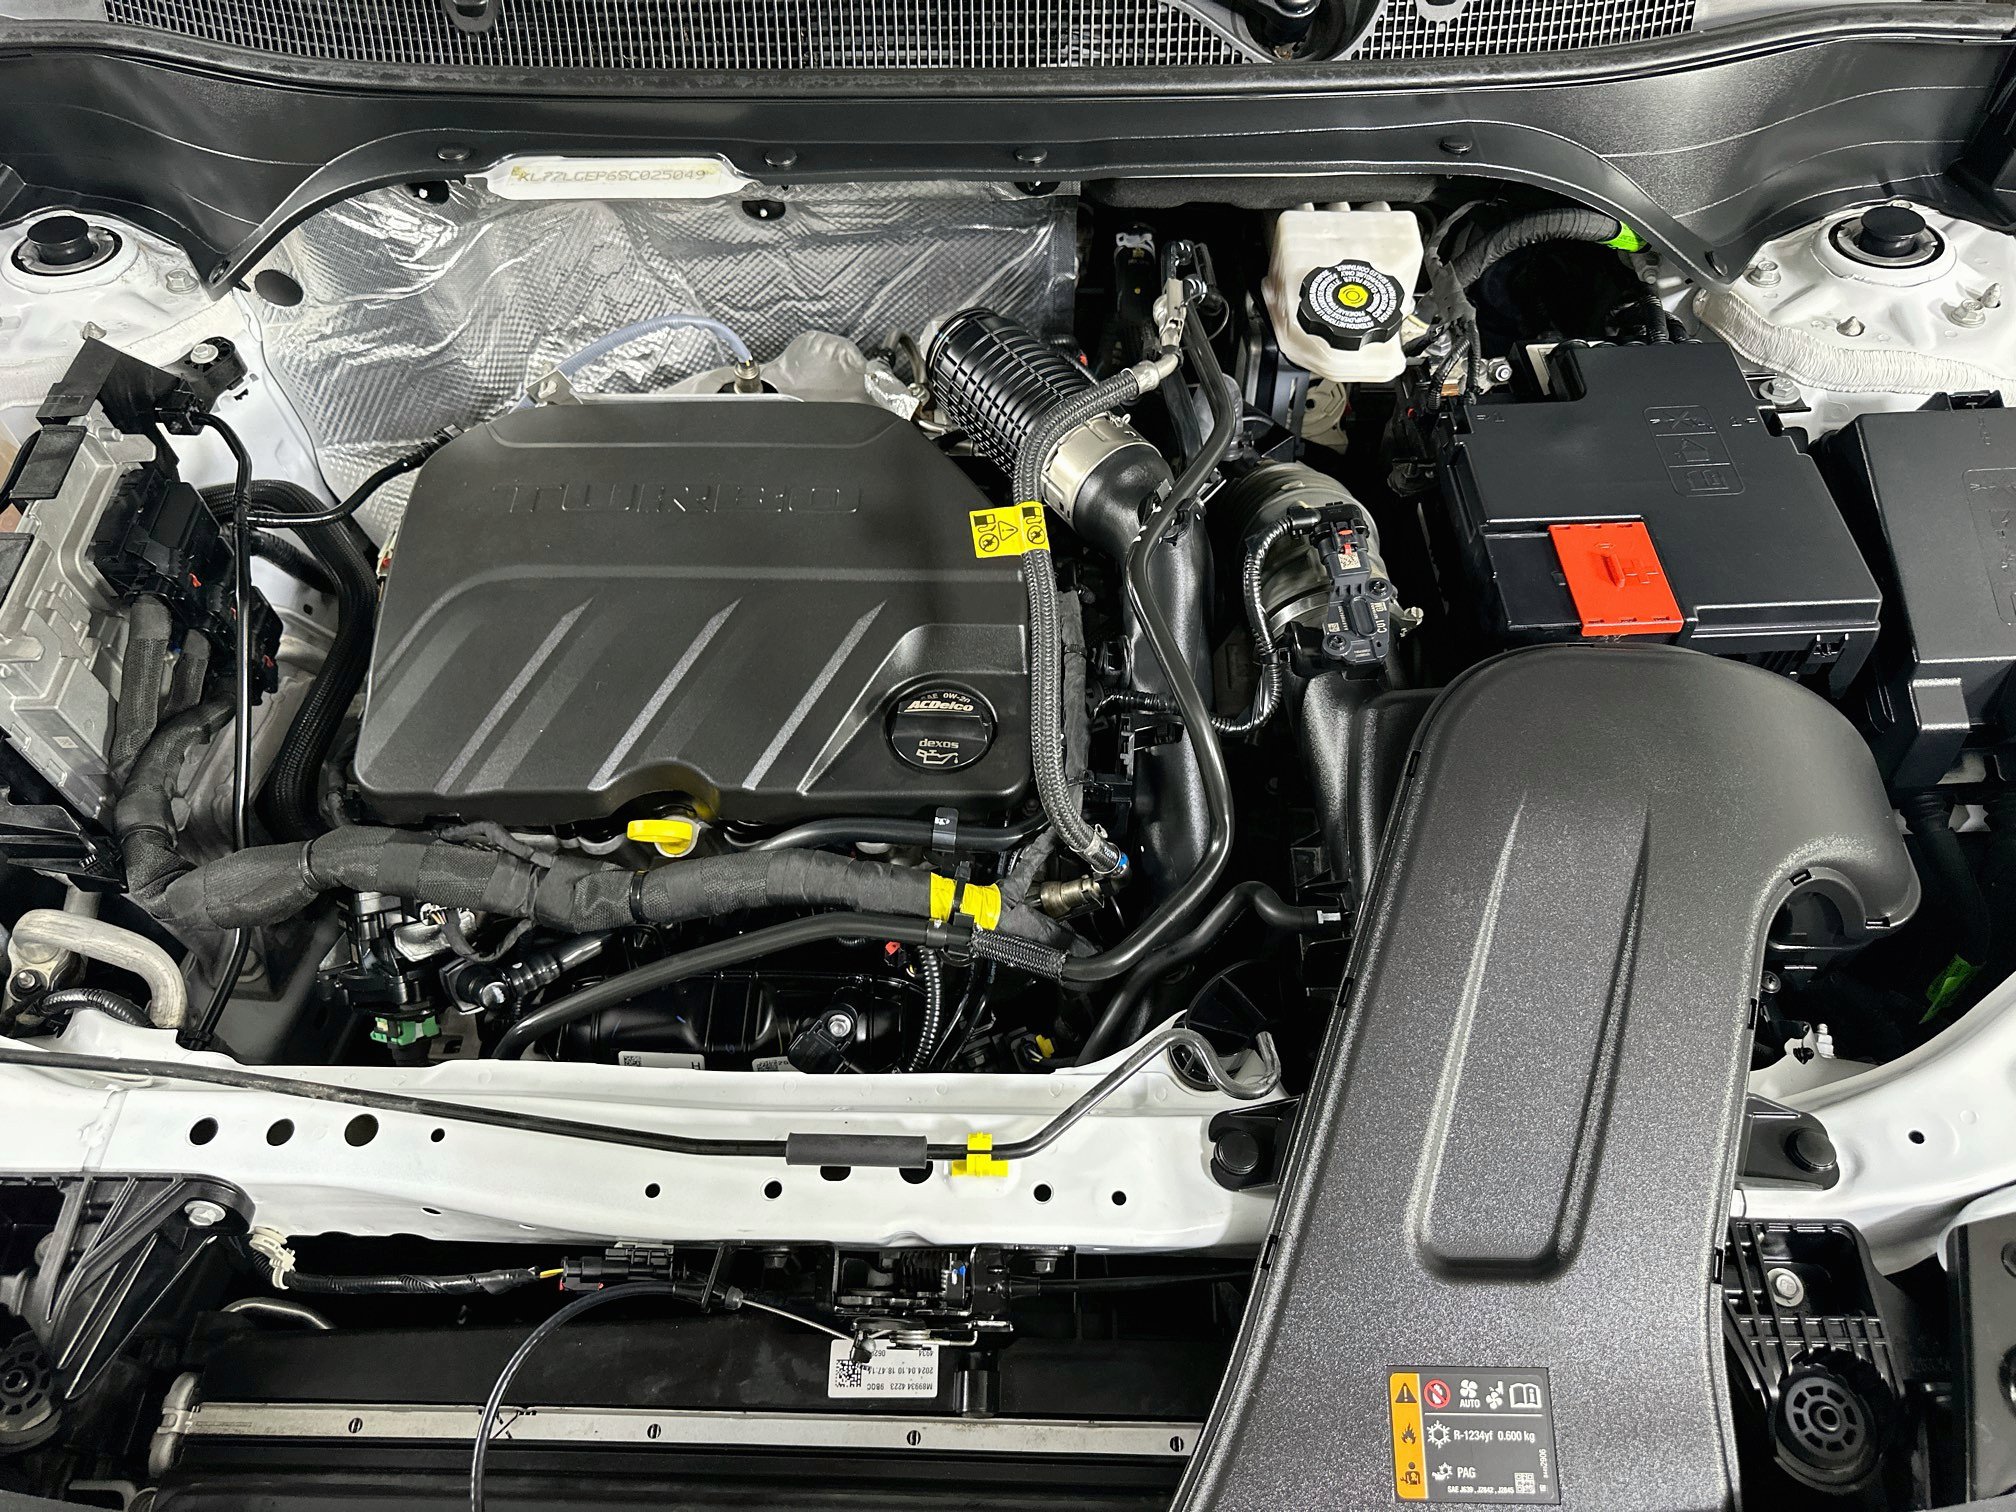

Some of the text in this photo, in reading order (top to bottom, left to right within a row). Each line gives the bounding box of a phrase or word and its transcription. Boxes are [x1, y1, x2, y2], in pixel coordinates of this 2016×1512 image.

[491, 483, 862, 513] TURBO
[907, 700, 974, 712] ACDelco
[919, 738, 960, 749] dexos
[1459, 1398, 1481, 1409] AUTO
[1453, 1429, 1536, 1444] R-1234yf 0.600 kg
[1457, 1466, 1477, 1479] PAG
[1447, 1485, 1459, 1493] SAE
